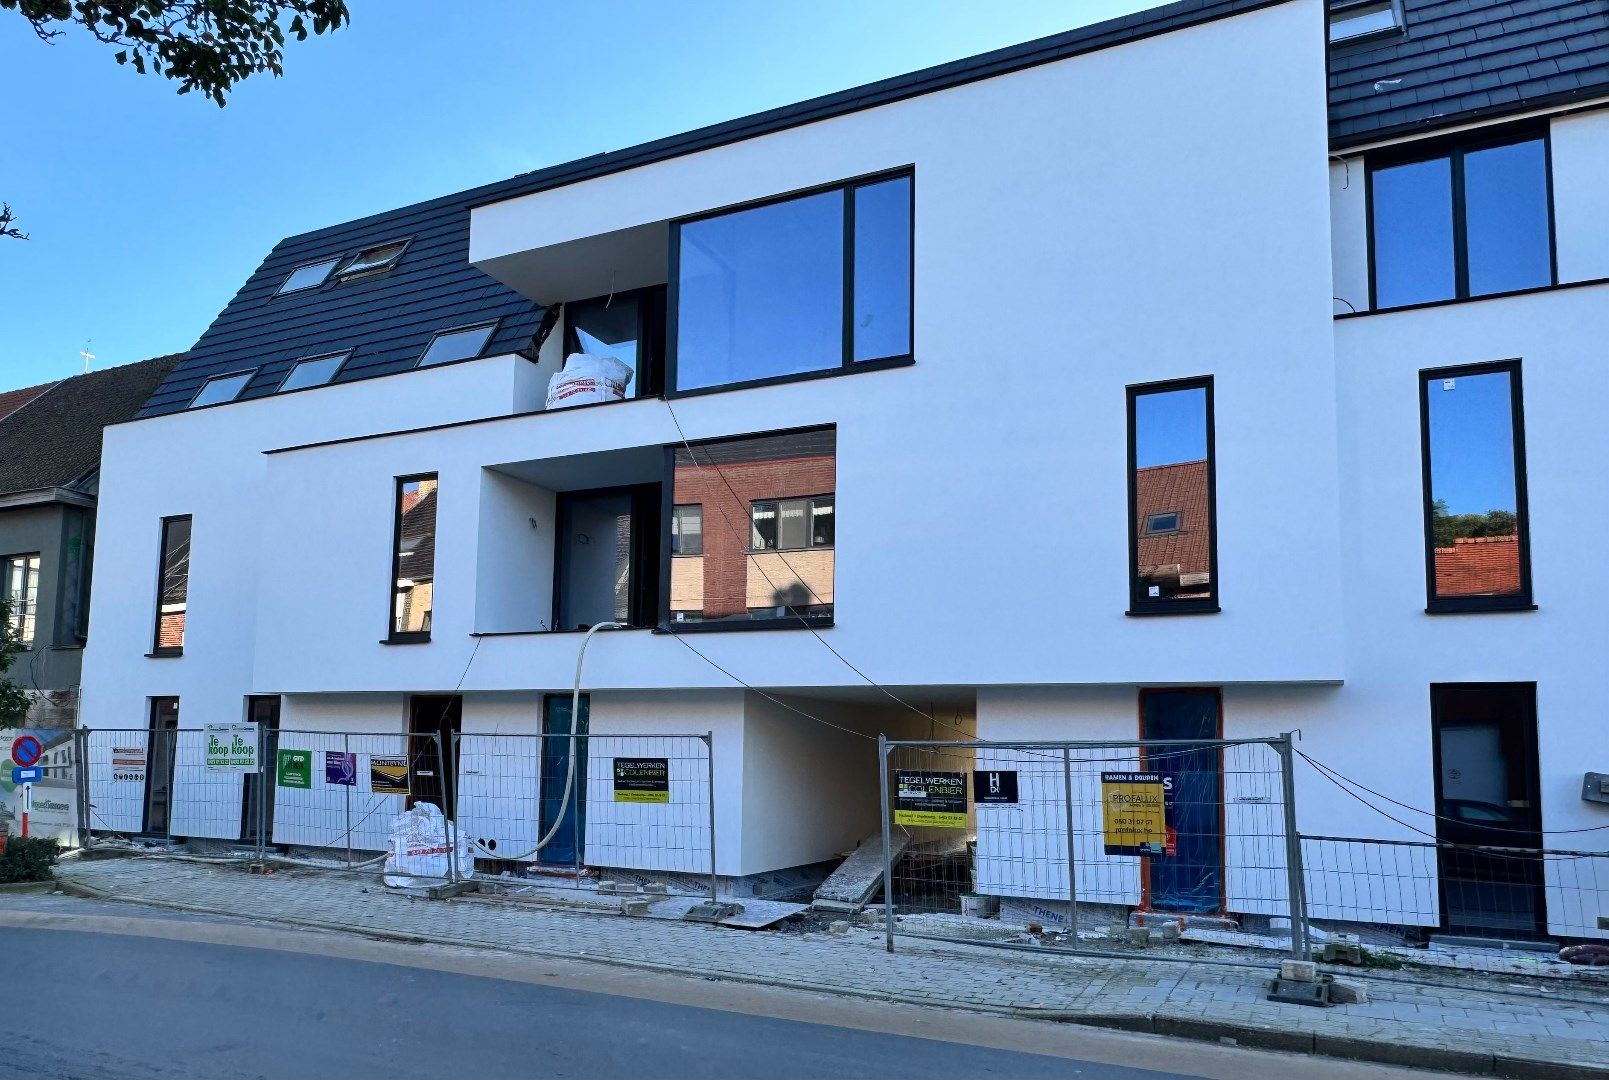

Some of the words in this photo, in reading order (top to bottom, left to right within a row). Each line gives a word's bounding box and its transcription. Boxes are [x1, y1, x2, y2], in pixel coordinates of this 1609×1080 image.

[209, 734, 219, 746] Te
[233, 734, 244, 746] Te
[208, 742, 229, 757] koop
[231, 742, 254, 757] koop
[616, 761, 666, 769] TEGELWERKEN
[898, 776, 963, 786] TEGELWERKEN
[908, 785, 963, 795] COLENBIER
[1112, 794, 1158, 803] PROFALUX
